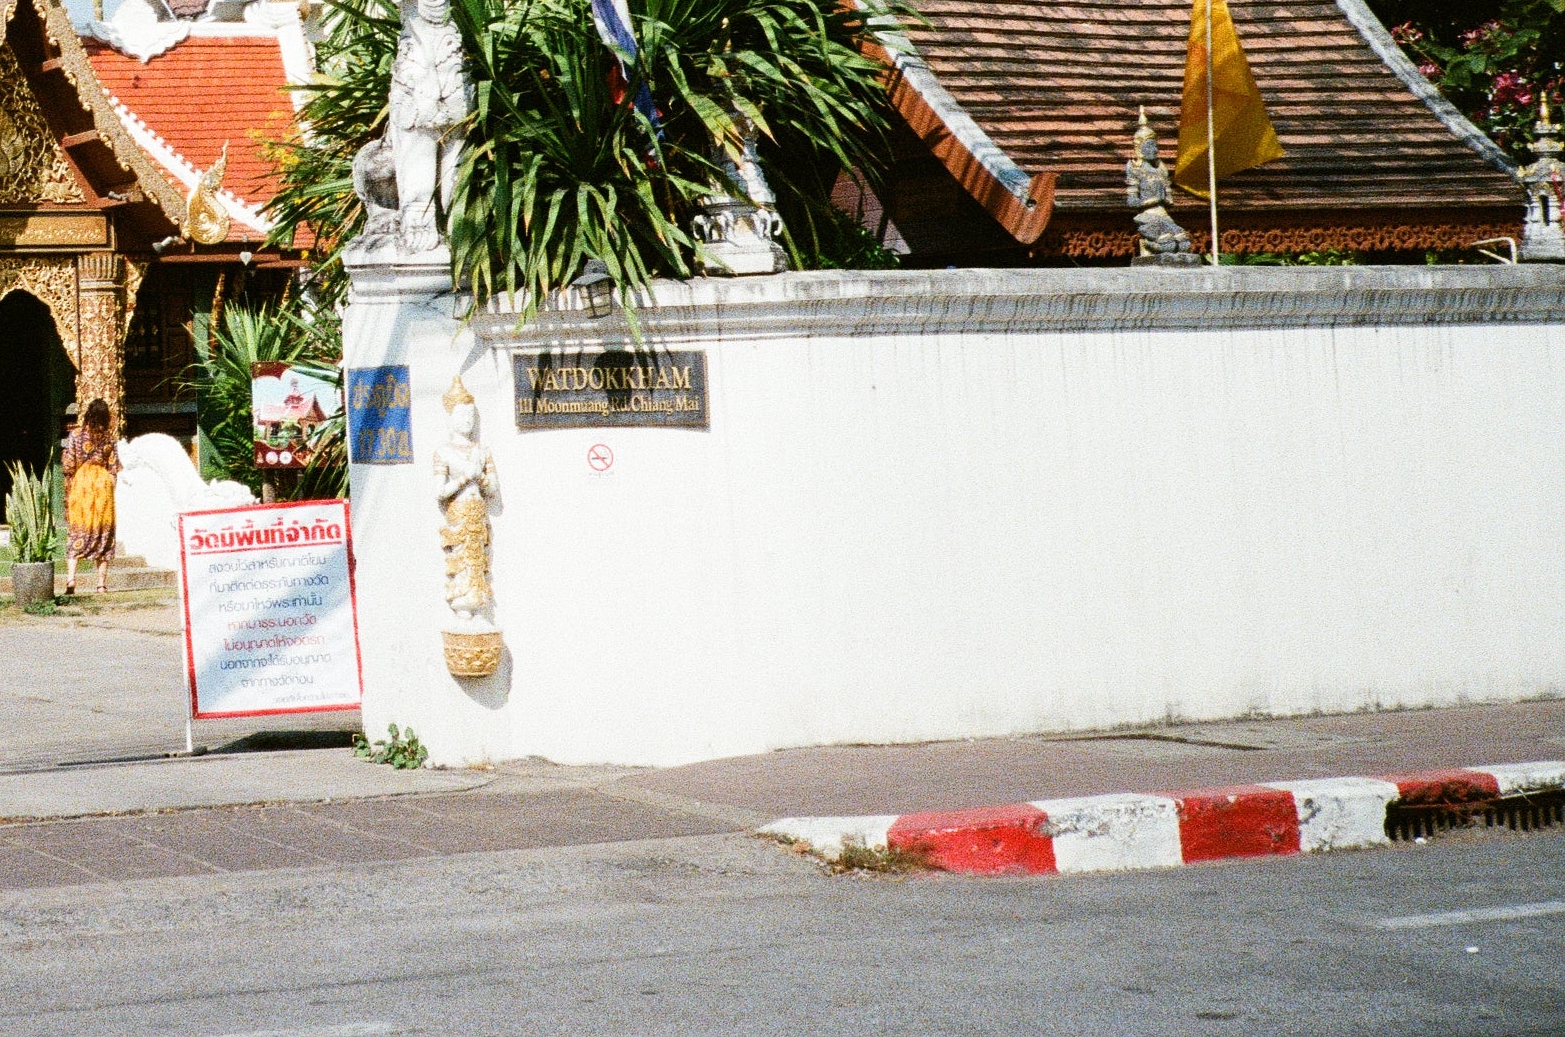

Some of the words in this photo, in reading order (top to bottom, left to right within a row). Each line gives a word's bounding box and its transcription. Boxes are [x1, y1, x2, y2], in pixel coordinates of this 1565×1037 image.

[536, 397, 610, 416] Moonmuang
[630, 396, 674, 415] Chiang
[675, 395, 700, 413] Mai
[189, 517, 342, 550] วัดมีพื้นที่จำกัด
